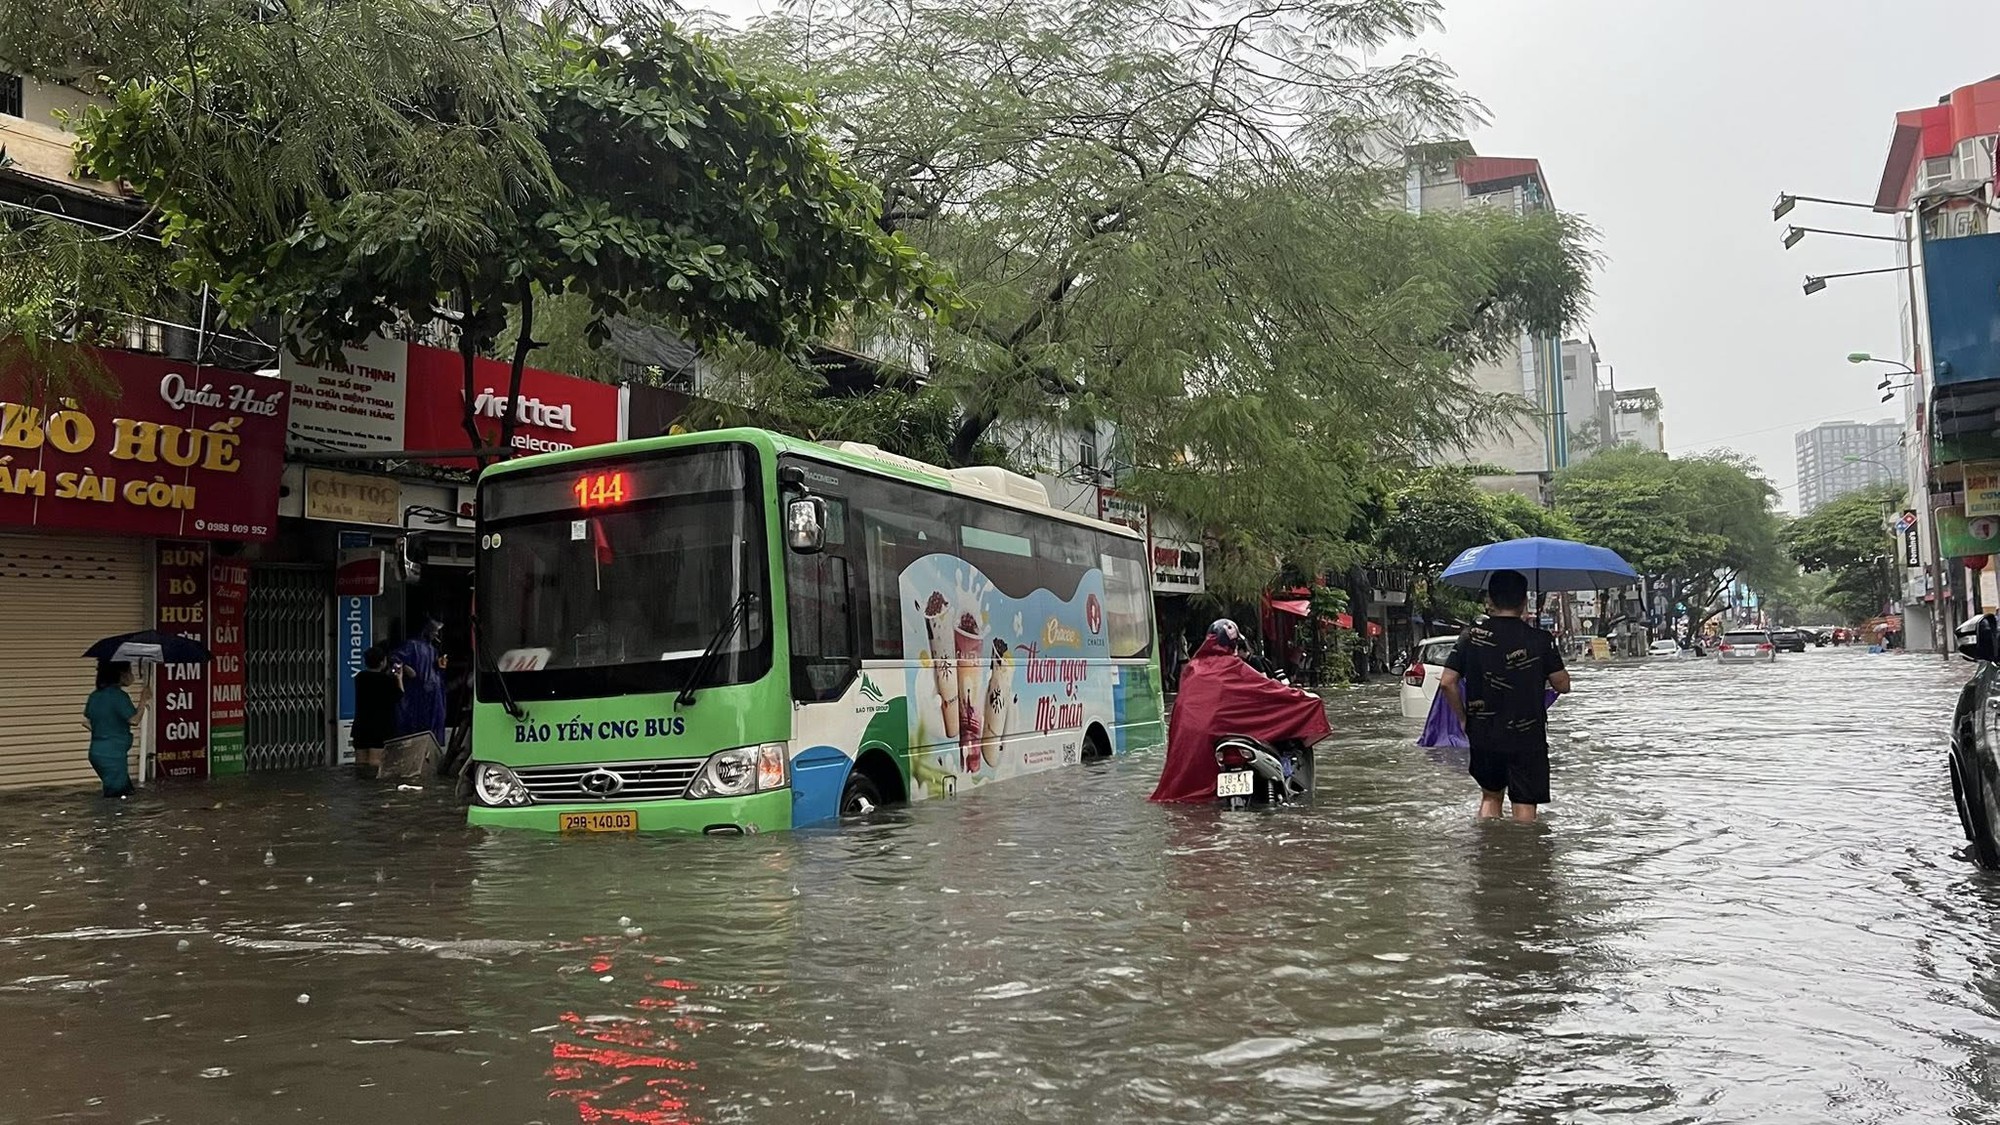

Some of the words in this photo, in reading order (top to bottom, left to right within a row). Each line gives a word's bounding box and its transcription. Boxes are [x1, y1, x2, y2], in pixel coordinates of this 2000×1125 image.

[357, 364, 396, 383] THỊNH
[161, 373, 225, 410] Quán
[228, 384, 284, 416] Huế
[0, 397, 95, 453] BÒ
[109, 416, 244, 472] HUẾ
[55, 467, 116, 502] SÀI
[123, 476, 196, 510] GÒN
[574, 473, 624, 508] 144
[207, 522, 229, 533] 0988
[232, 523, 249, 534] 009
[251, 525, 268, 535] 952
[161, 547, 204, 566] BÚN
[1908, 530, 1918, 565] Domino's
[169, 574, 196, 594] BÒ
[161, 601, 204, 622] HUẾ
[347, 597, 363, 677] vinapho
[215, 652, 239, 673] TÓC
[166, 687, 193, 710] SÀI
[212, 684, 242, 702] NAM
[165, 717, 200, 740] GÒN
[515, 719, 550, 743] BẢO
[556, 714, 594, 741] YẾN
[598, 721, 639, 740] CNG
[644, 716, 685, 738] BUS
[566, 814, 631, 830] 29B-140.03
